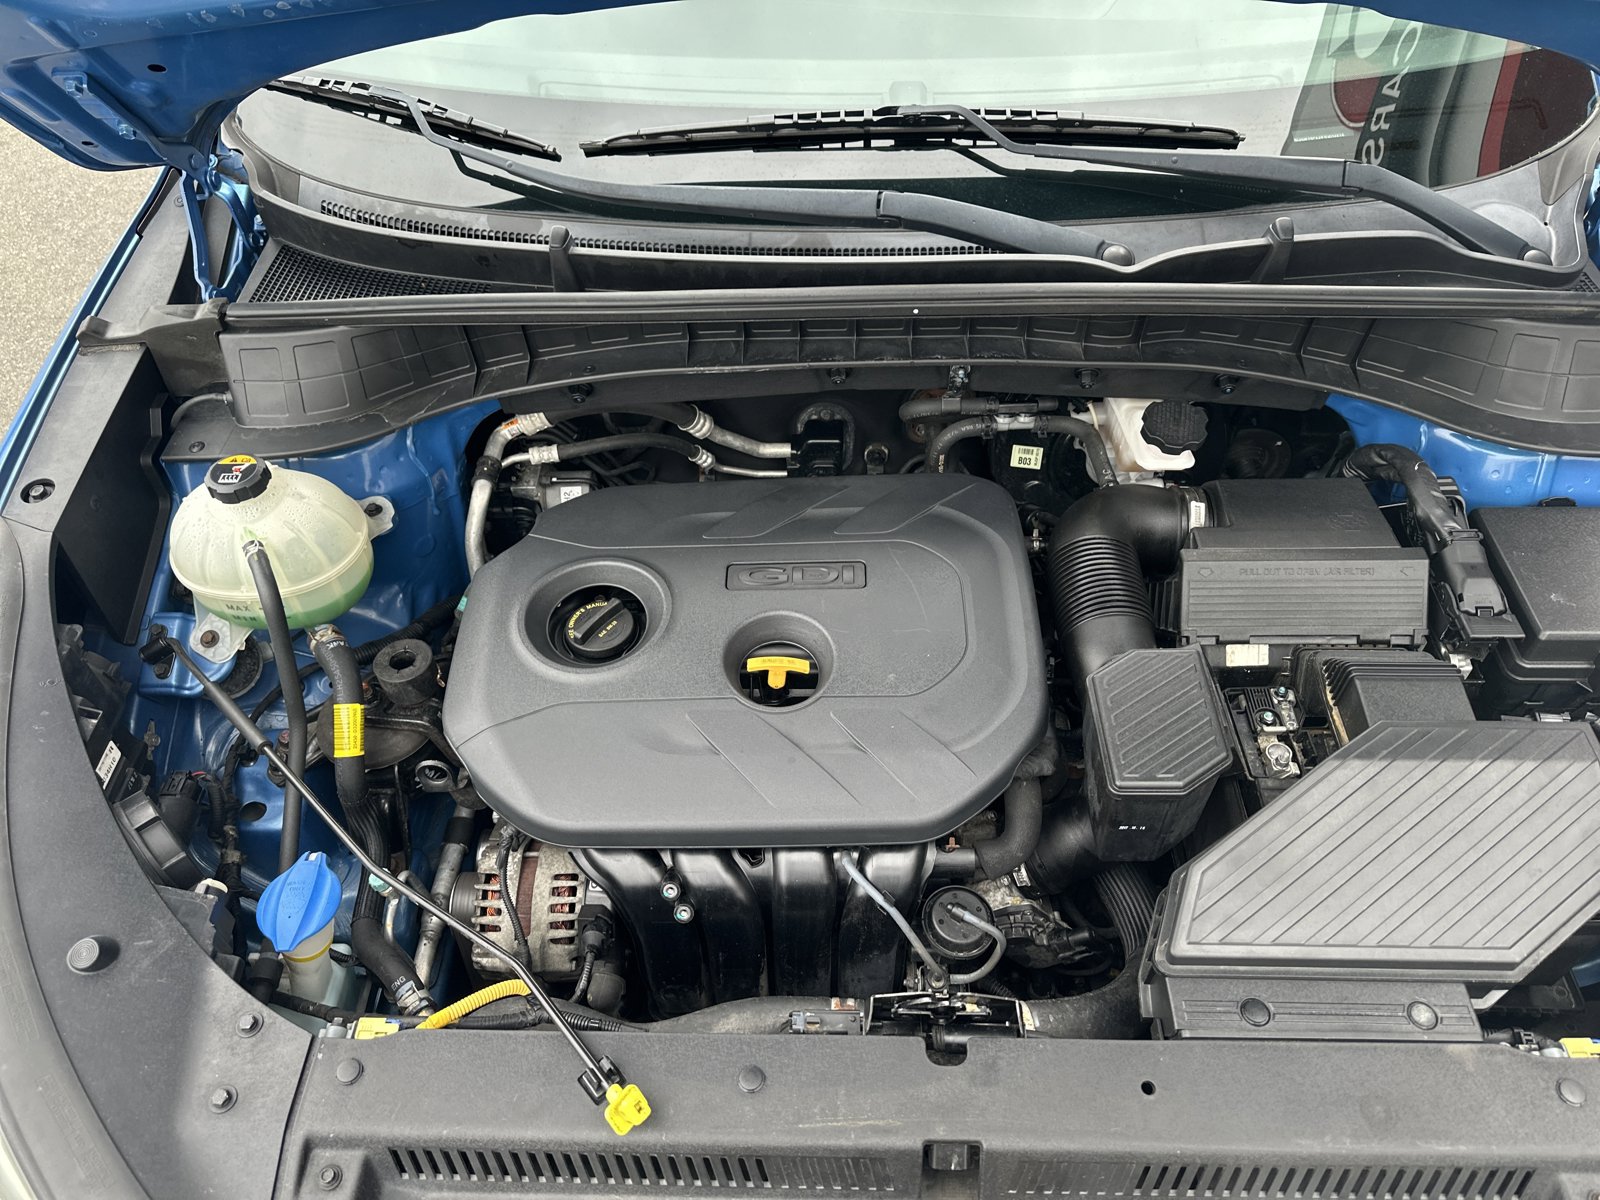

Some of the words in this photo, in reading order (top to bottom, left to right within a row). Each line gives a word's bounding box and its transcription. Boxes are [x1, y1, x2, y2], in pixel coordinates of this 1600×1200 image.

[1017, 456, 1032, 466] B03
[738, 564, 855, 587] GDI
[225, 603, 252, 612] MAX
[231, 614, 258, 622] MIN
[390, 975, 406, 991] ENG
